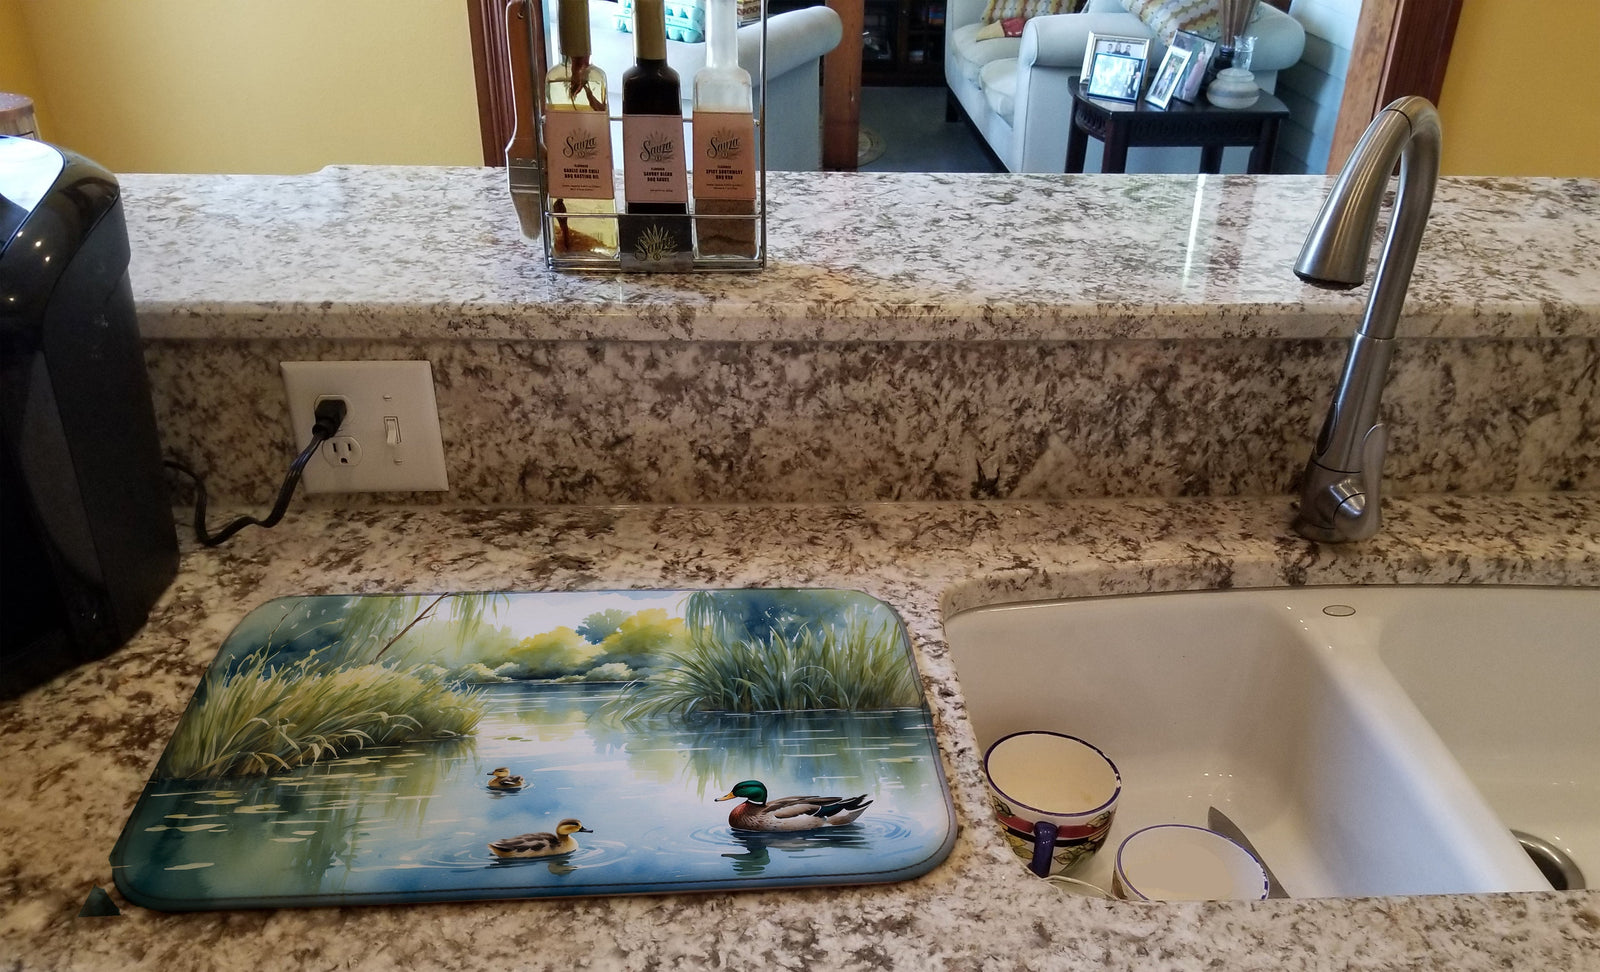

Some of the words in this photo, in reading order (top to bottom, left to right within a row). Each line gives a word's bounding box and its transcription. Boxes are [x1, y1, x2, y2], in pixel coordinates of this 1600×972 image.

[563, 135, 597, 158] Sauza
[640, 139, 673, 162] Sauza
[706, 136, 740, 159] Sauza
